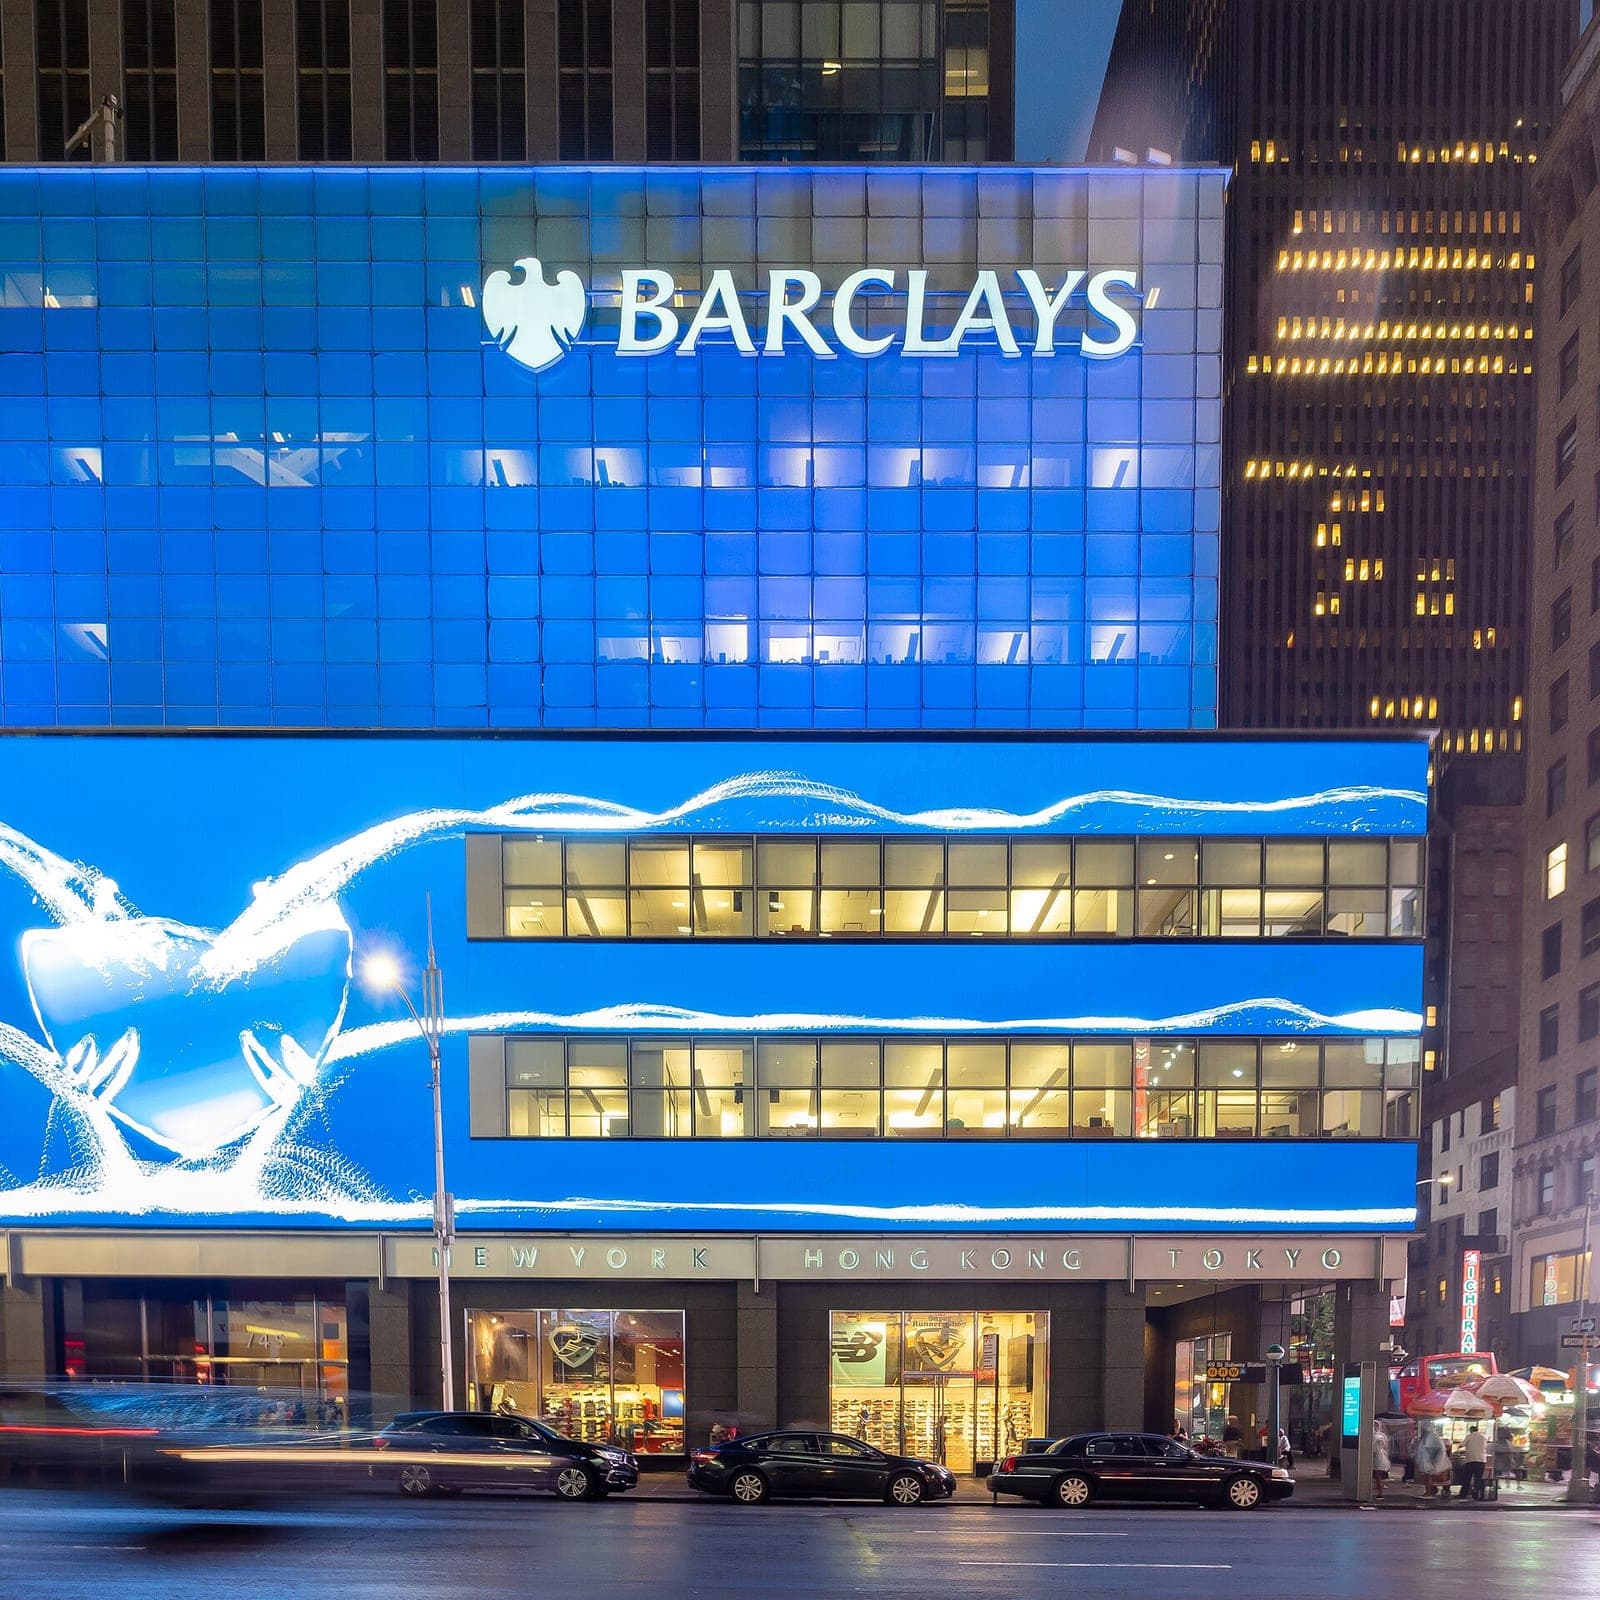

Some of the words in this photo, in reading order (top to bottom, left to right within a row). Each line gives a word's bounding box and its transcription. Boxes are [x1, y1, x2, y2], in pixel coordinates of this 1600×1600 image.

[613, 268, 1138, 360] BARCLAYS
[568, 1246, 710, 1269] YORK
[804, 1248, 929, 1270] HONG
[960, 1248, 1082, 1270] KONG
[1168, 1248, 1343, 1270] TOKYO
[1462, 1265, 1477, 1354] ICHIRAN
